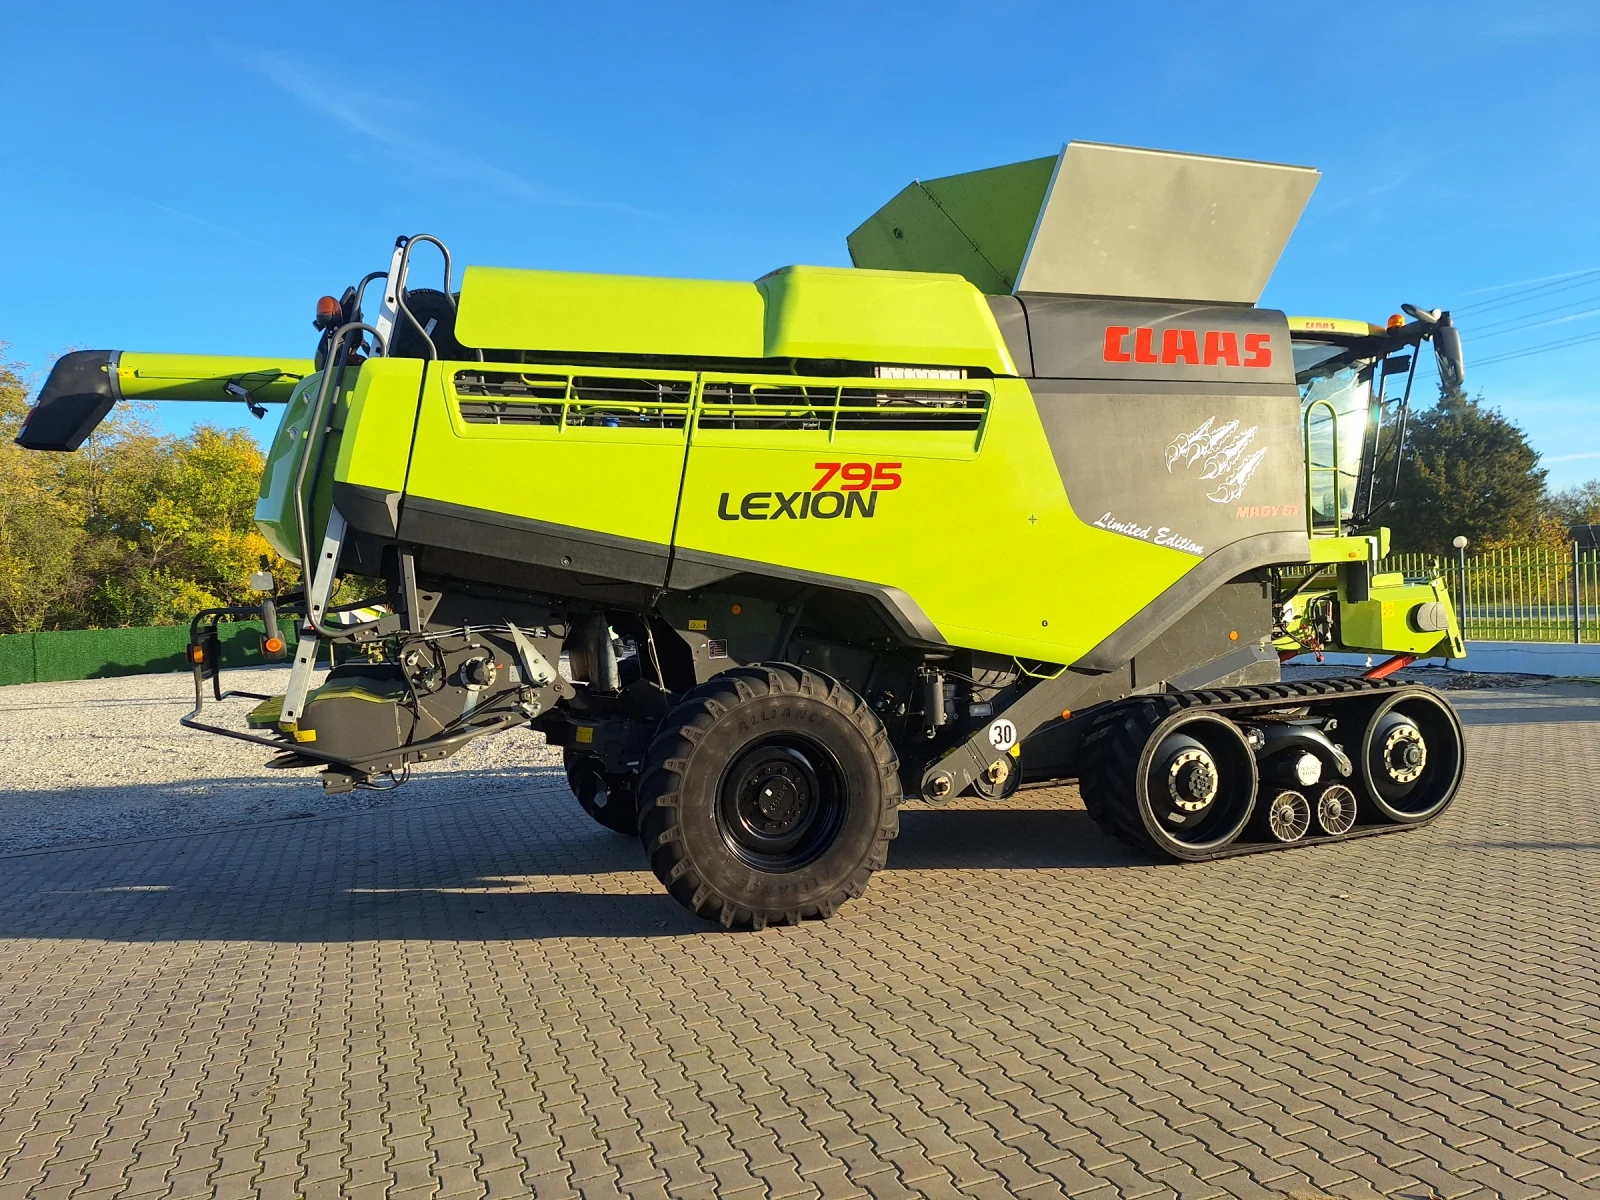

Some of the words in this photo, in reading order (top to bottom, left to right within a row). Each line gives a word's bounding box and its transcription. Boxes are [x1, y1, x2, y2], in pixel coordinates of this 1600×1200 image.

[1305, 322, 1335, 330] CLAAS
[1103, 325, 1272, 368] CLAAS
[812, 462, 903, 491] 795
[718, 491, 877, 521] LEXION
[1236, 505, 1280, 518] MAGY
[1093, 511, 1152, 539] Limited
[1153, 526, 1204, 554] Edition
[994, 725, 1012, 744] 30
